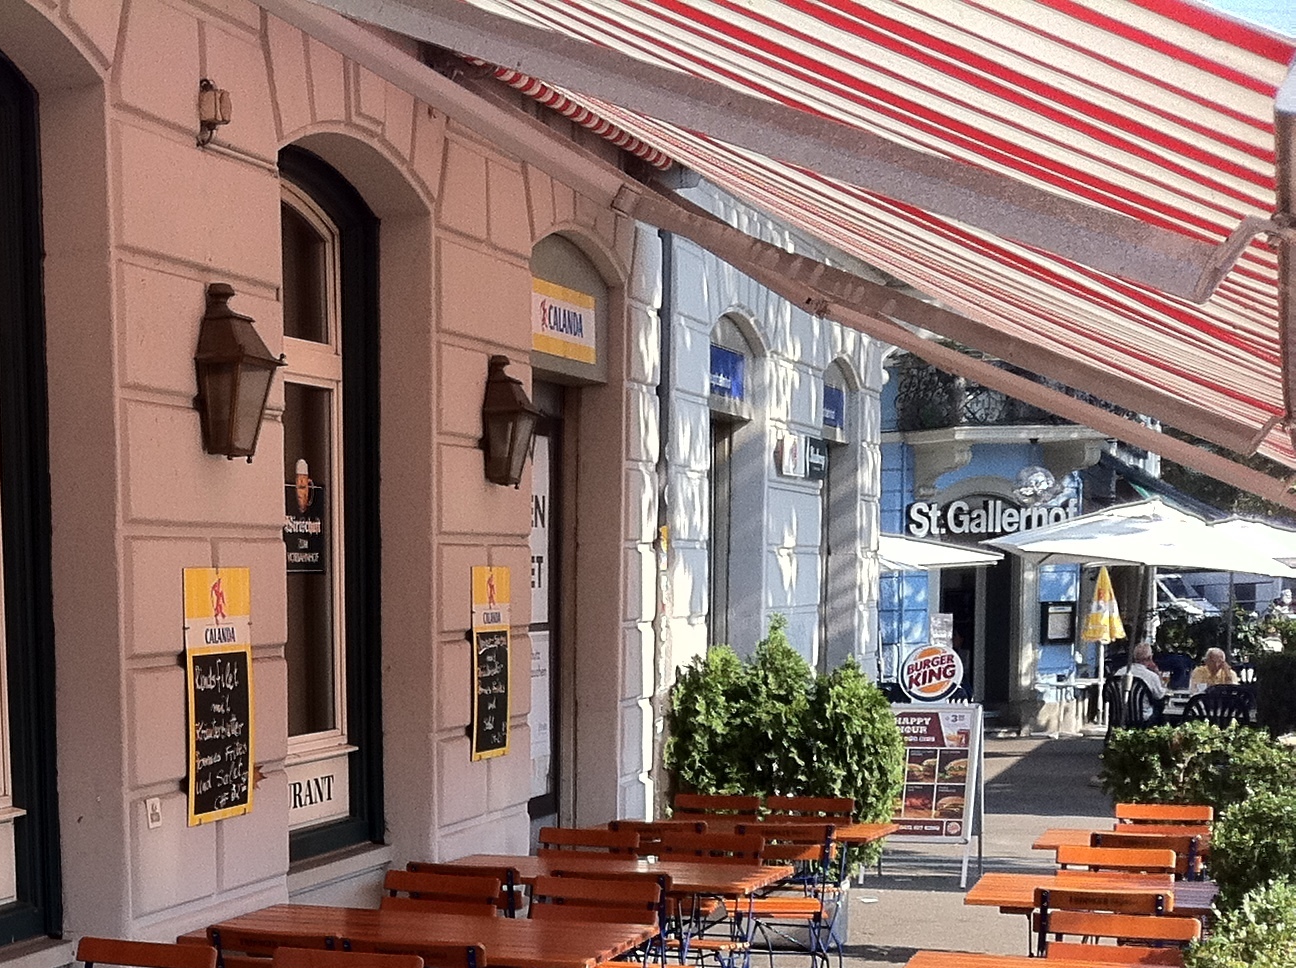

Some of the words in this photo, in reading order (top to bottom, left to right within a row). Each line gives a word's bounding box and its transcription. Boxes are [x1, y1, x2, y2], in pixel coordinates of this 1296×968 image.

[548, 304, 584, 338] CALANDA
[204, 627, 236, 644] CALANDA
[907, 654, 955, 675] BURGER
[907, 664, 956, 689] KING
[288, 775, 334, 809] RANT
